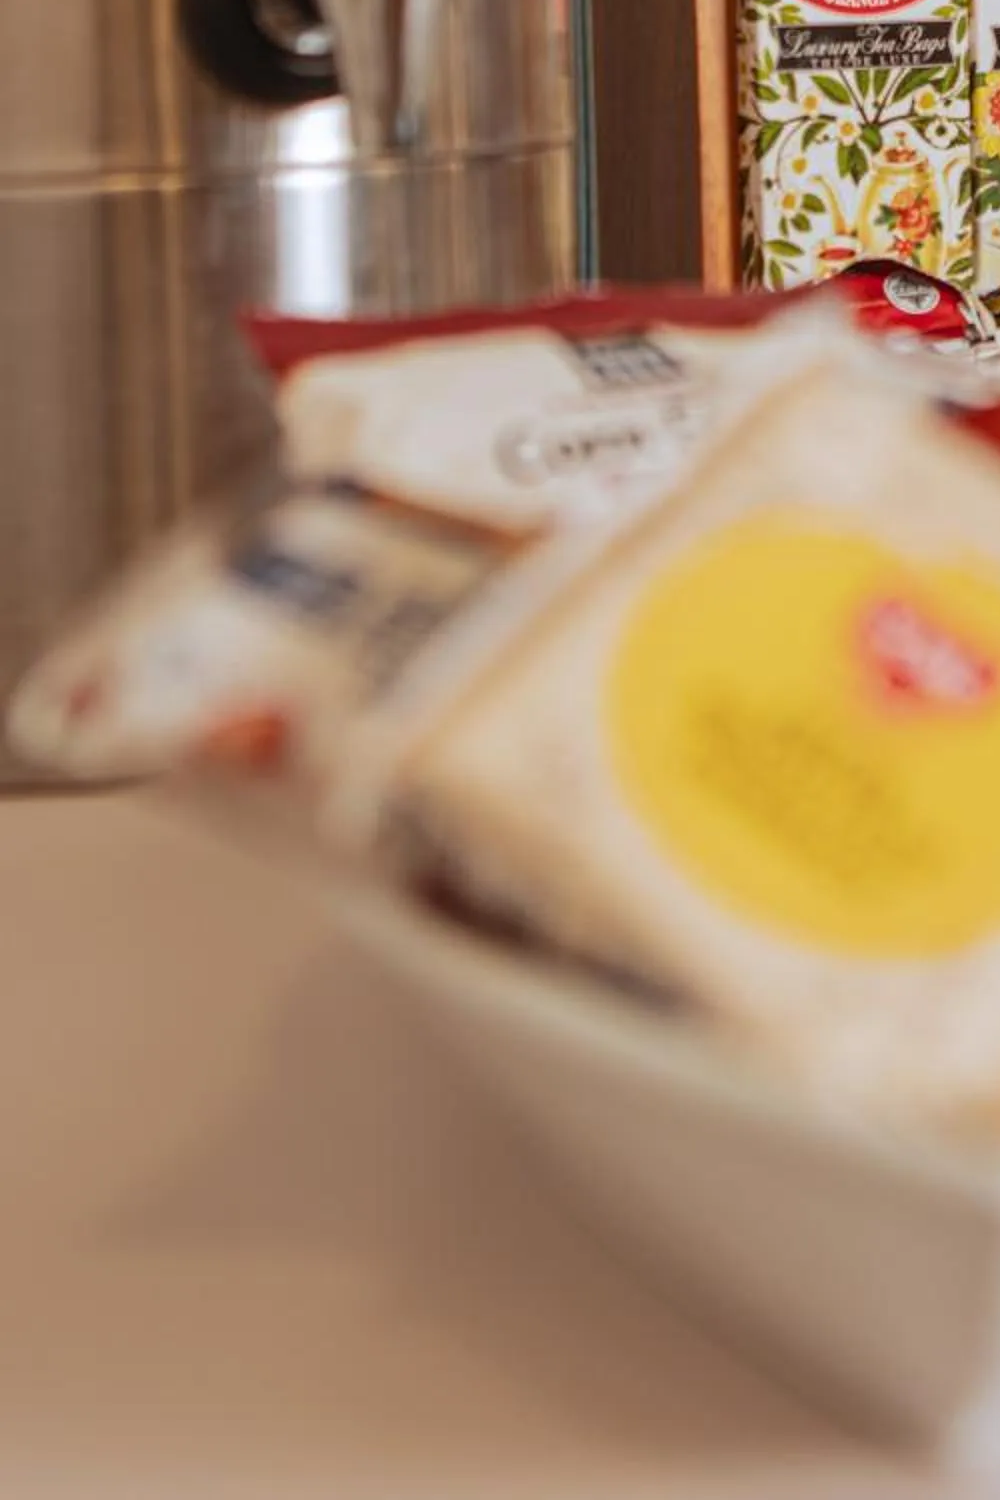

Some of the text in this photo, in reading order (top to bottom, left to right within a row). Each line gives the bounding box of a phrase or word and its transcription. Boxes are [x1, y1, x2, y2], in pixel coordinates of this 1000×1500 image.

[781, 25, 947, 60] Luxury Tea Bags
